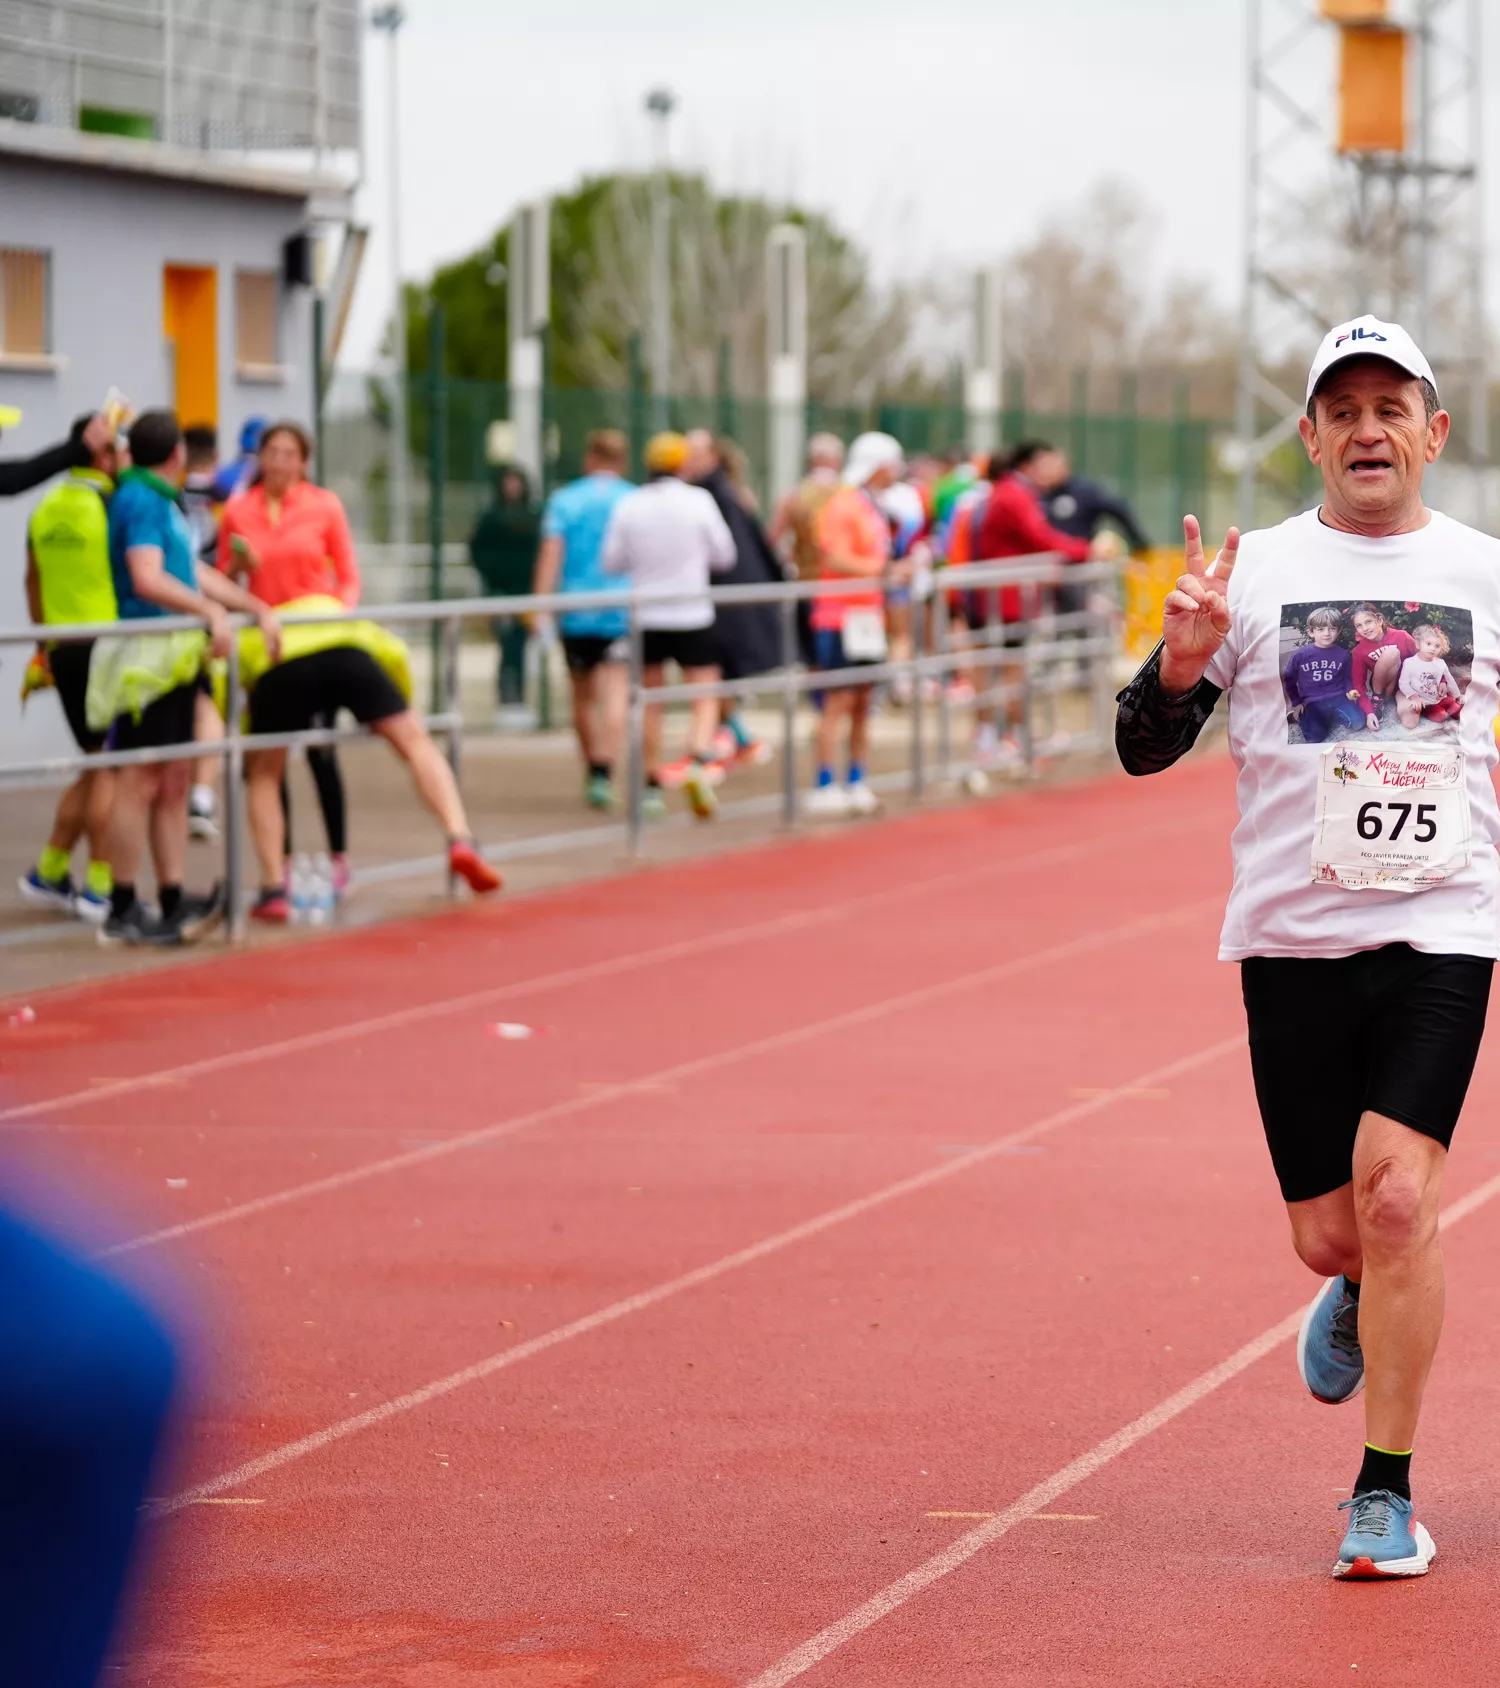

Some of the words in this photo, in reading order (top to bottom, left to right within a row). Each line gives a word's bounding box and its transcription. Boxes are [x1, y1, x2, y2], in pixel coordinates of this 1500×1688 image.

[1335, 327, 1387, 348] FILA
[1312, 669, 1333, 682] 56
[1356, 801, 1437, 843] 675
